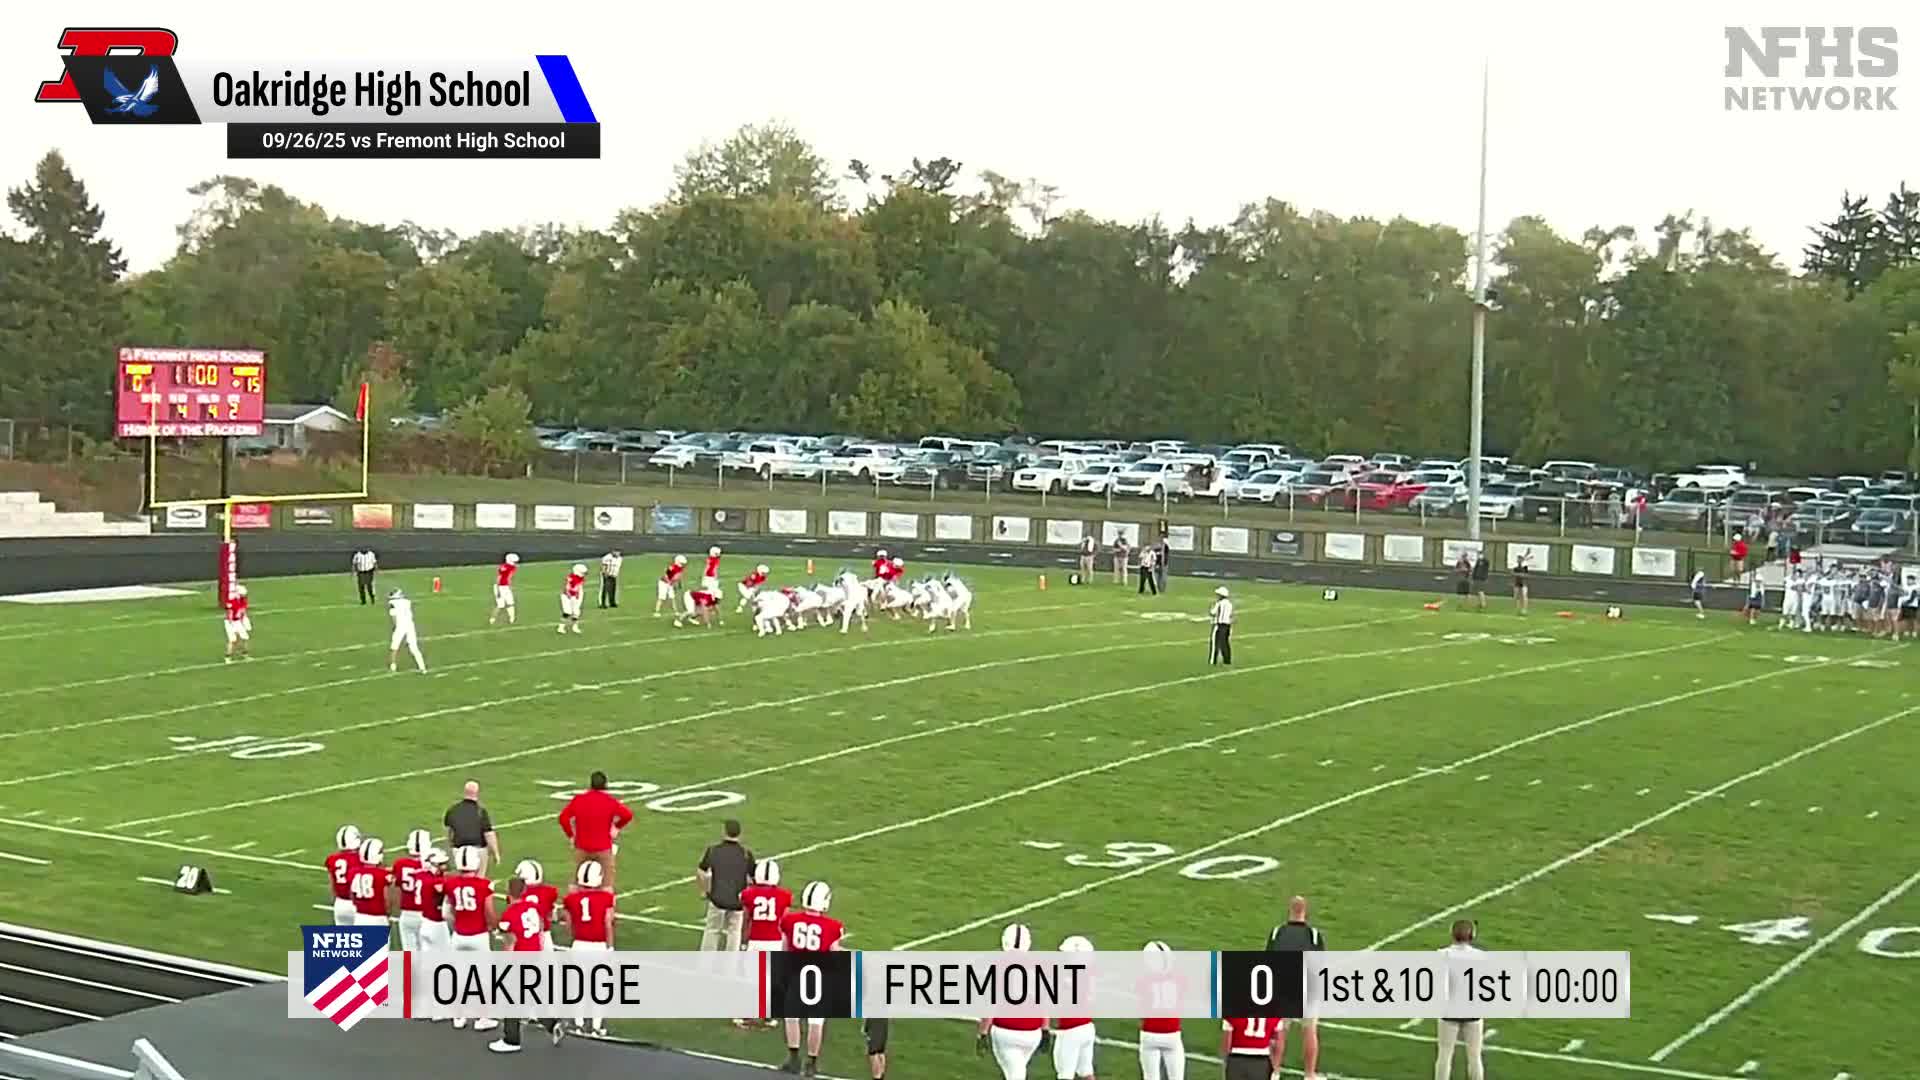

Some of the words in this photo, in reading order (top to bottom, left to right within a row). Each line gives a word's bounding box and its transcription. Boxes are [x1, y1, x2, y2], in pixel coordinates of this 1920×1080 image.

[176, 865, 199, 889] 20
[335, 858, 348, 884] 2
[350, 873, 375, 899] 48
[453, 886, 477, 911] 16
[580, 897, 592, 922] 1
[753, 896, 777, 921] 21
[792, 921, 823, 950] 66
